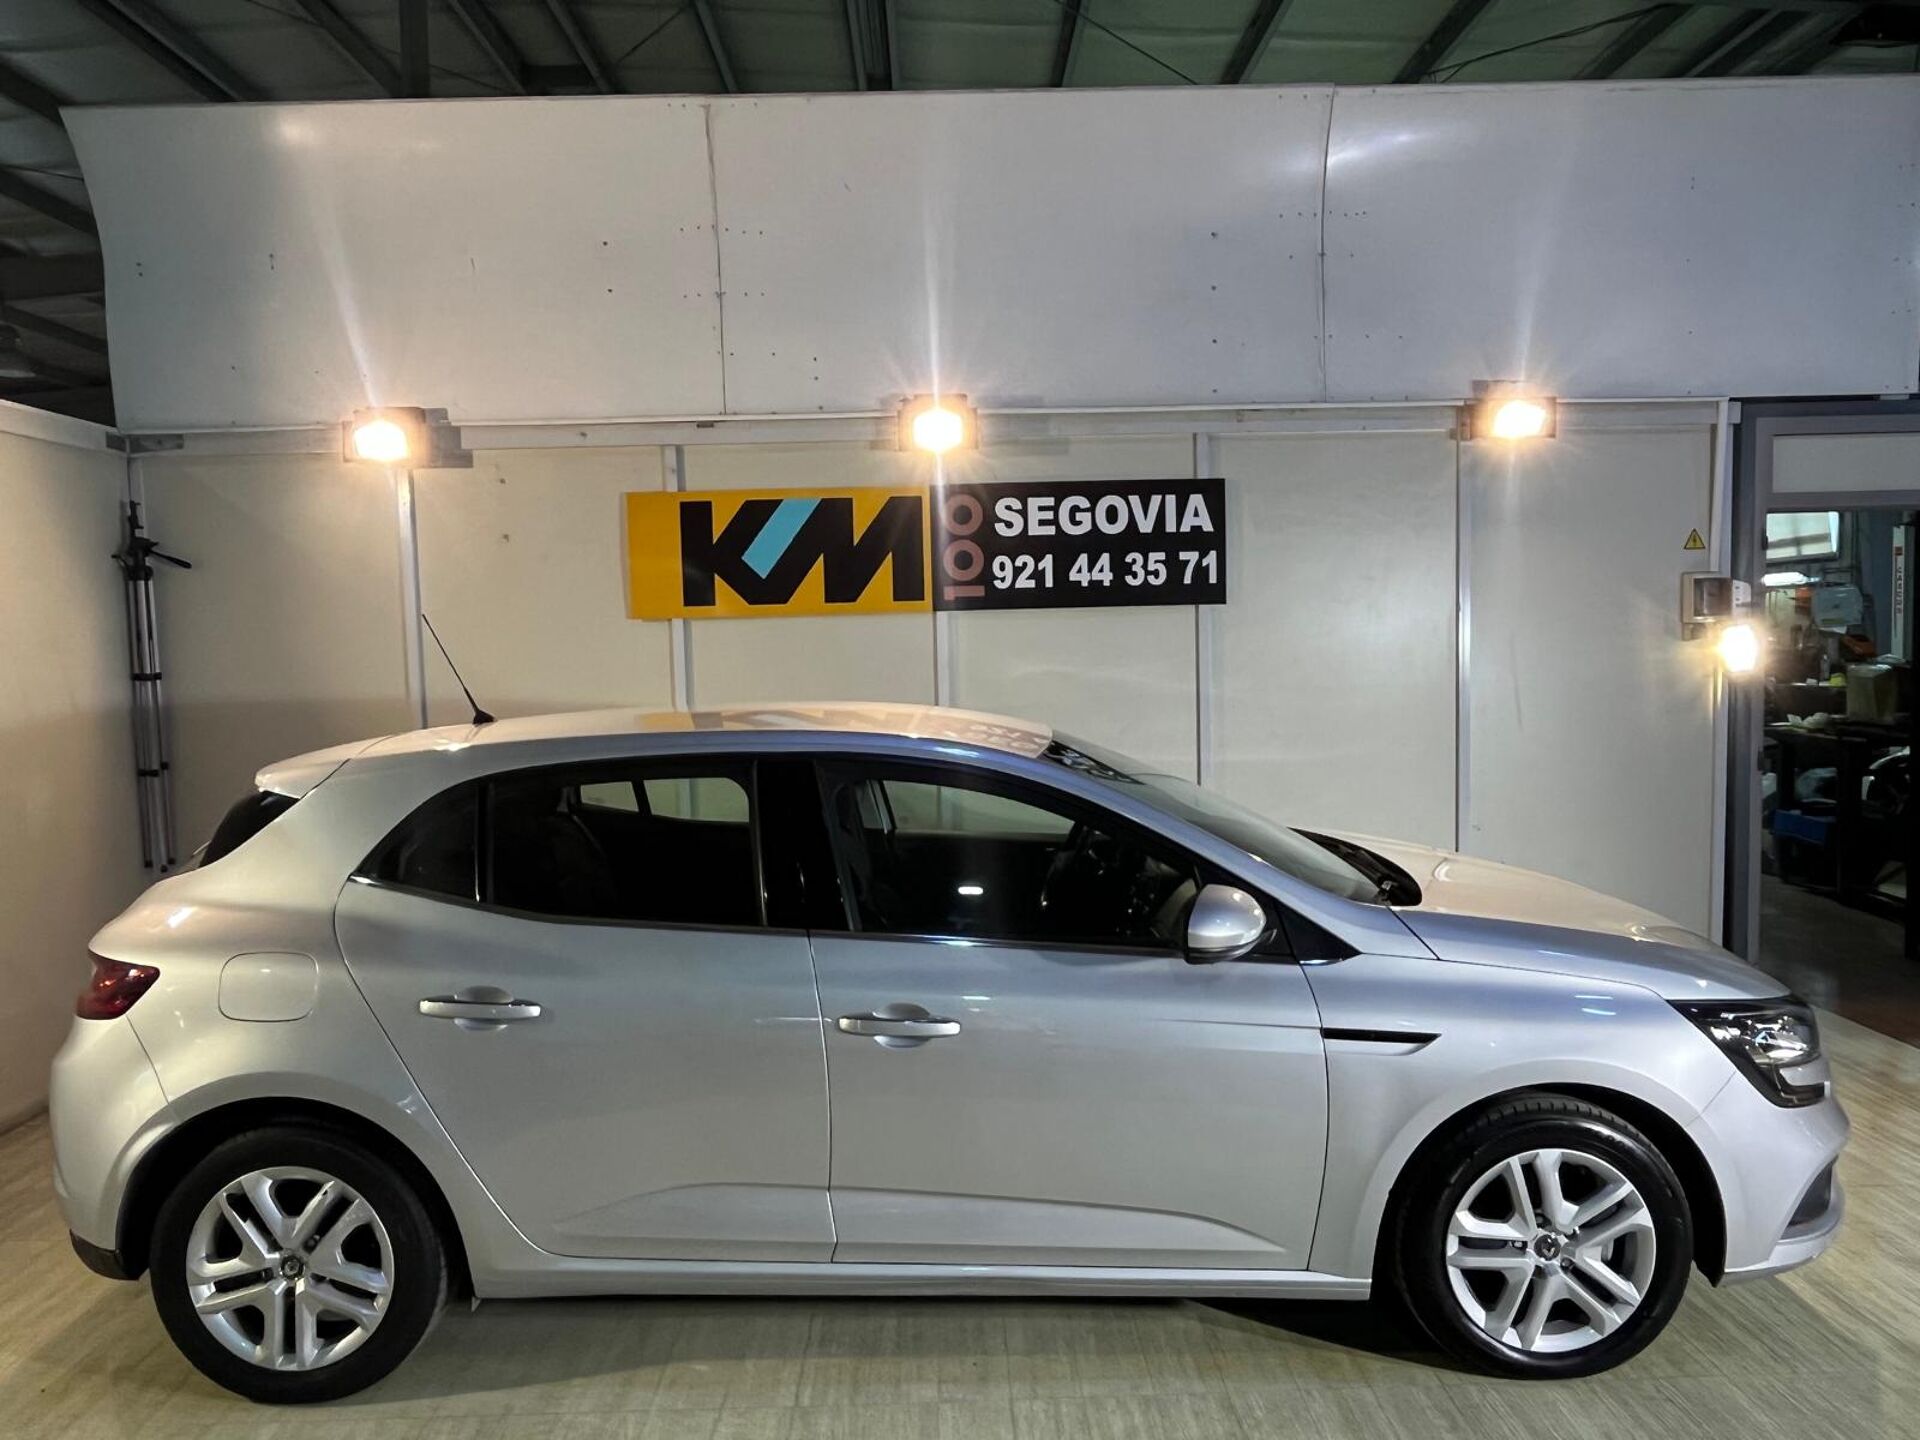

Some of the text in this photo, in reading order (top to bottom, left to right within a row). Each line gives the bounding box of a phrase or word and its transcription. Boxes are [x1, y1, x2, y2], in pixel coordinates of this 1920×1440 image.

[680, 495, 926, 607] KM
[943, 493, 986, 601] 100
[994, 493, 1215, 537] SEGOVIA
[992, 550, 1218, 589] 921 44 35 71
